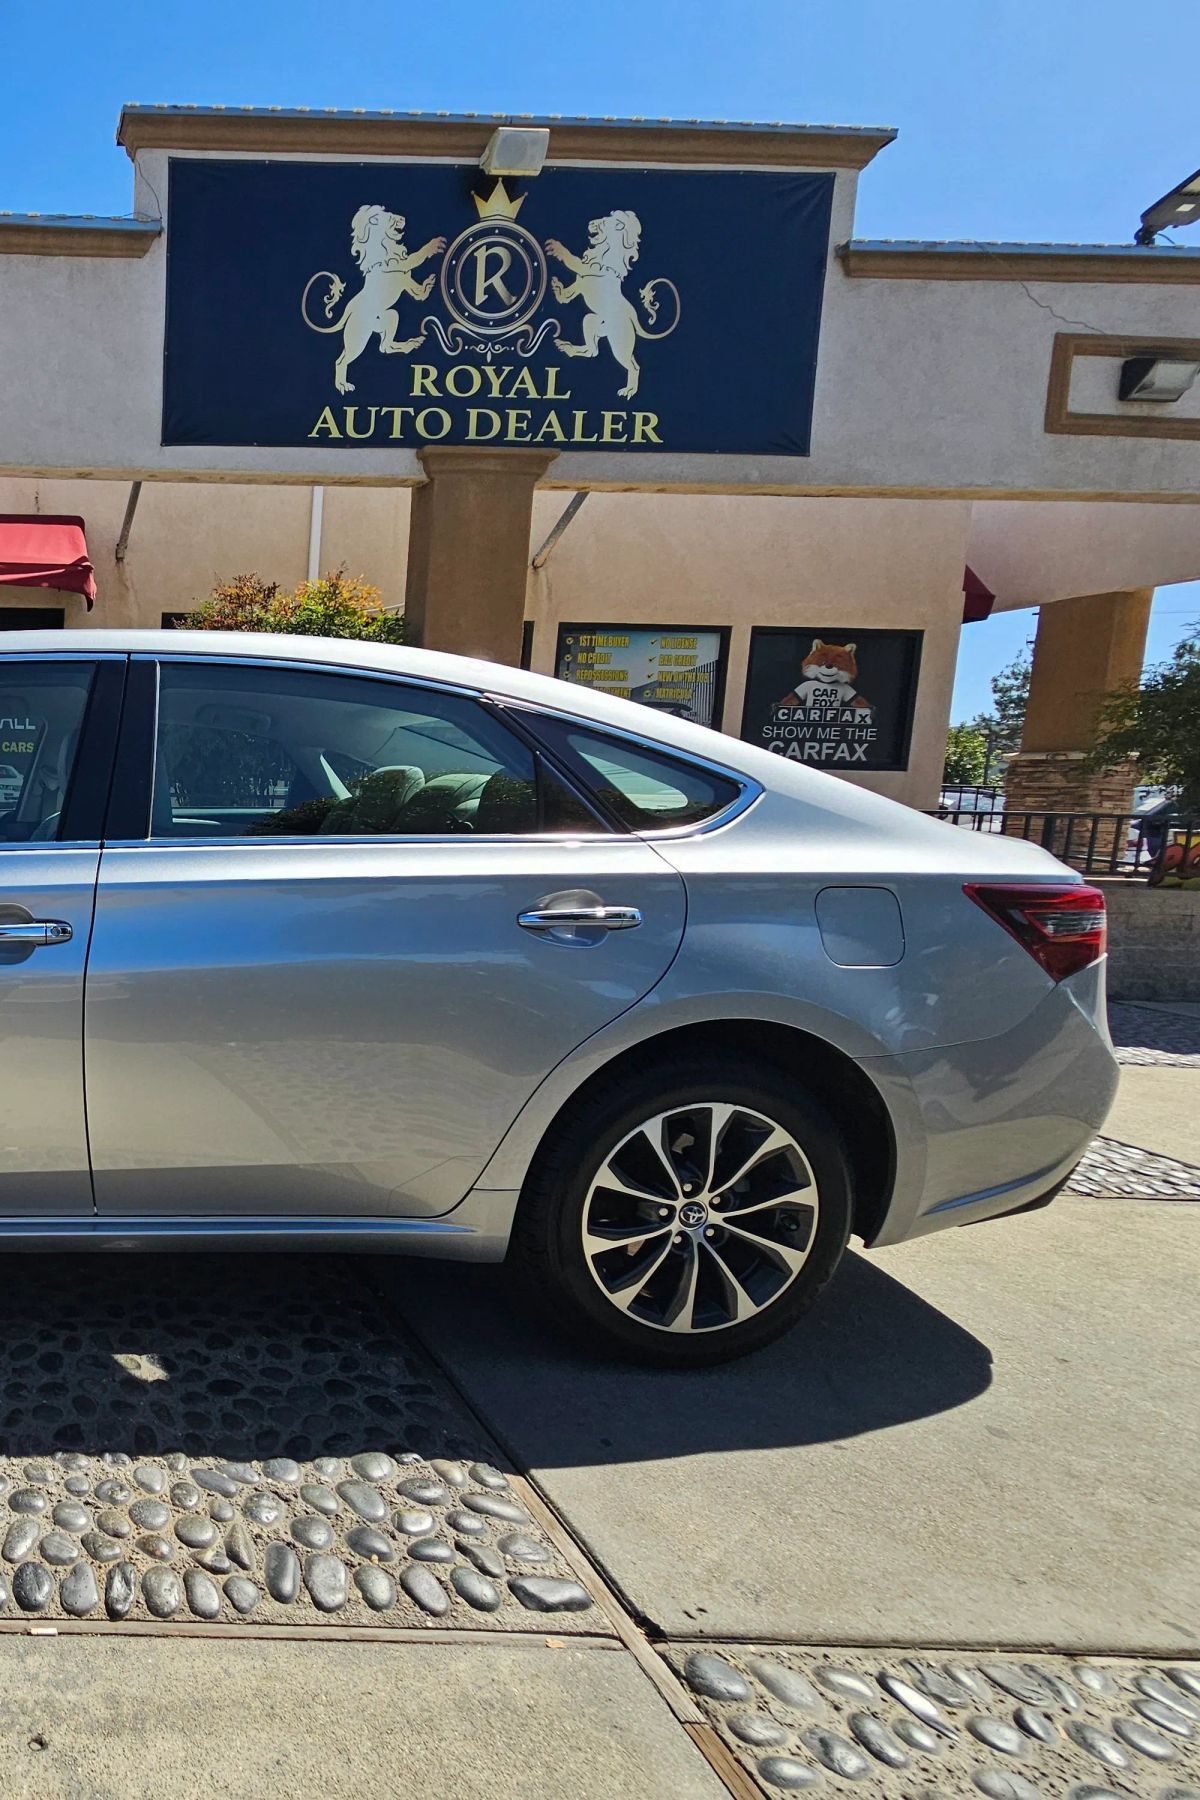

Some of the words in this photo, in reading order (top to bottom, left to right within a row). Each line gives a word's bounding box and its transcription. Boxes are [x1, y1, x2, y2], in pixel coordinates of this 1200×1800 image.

[473, 245, 517, 306] R
[409, 363, 572, 400] ROYAL
[307, 406, 452, 440] AUTO
[465, 408, 664, 443] DEALER
[579, 635, 590, 647] 1ST
[591, 635, 607, 647] TIME
[577, 652, 587, 664] NO
[588, 652, 612, 664] CREDIT
[812, 688, 839, 699] CAR
[812, 699, 836, 707] FOX
[777, 708, 870, 724] CARFAX
[762, 725, 814, 739] SHOW
[816, 727, 842, 739] ME
[845, 728, 878, 740] THE
[1, 741, 35, 753] CARS
[767, 740, 870, 761] CARFAX
